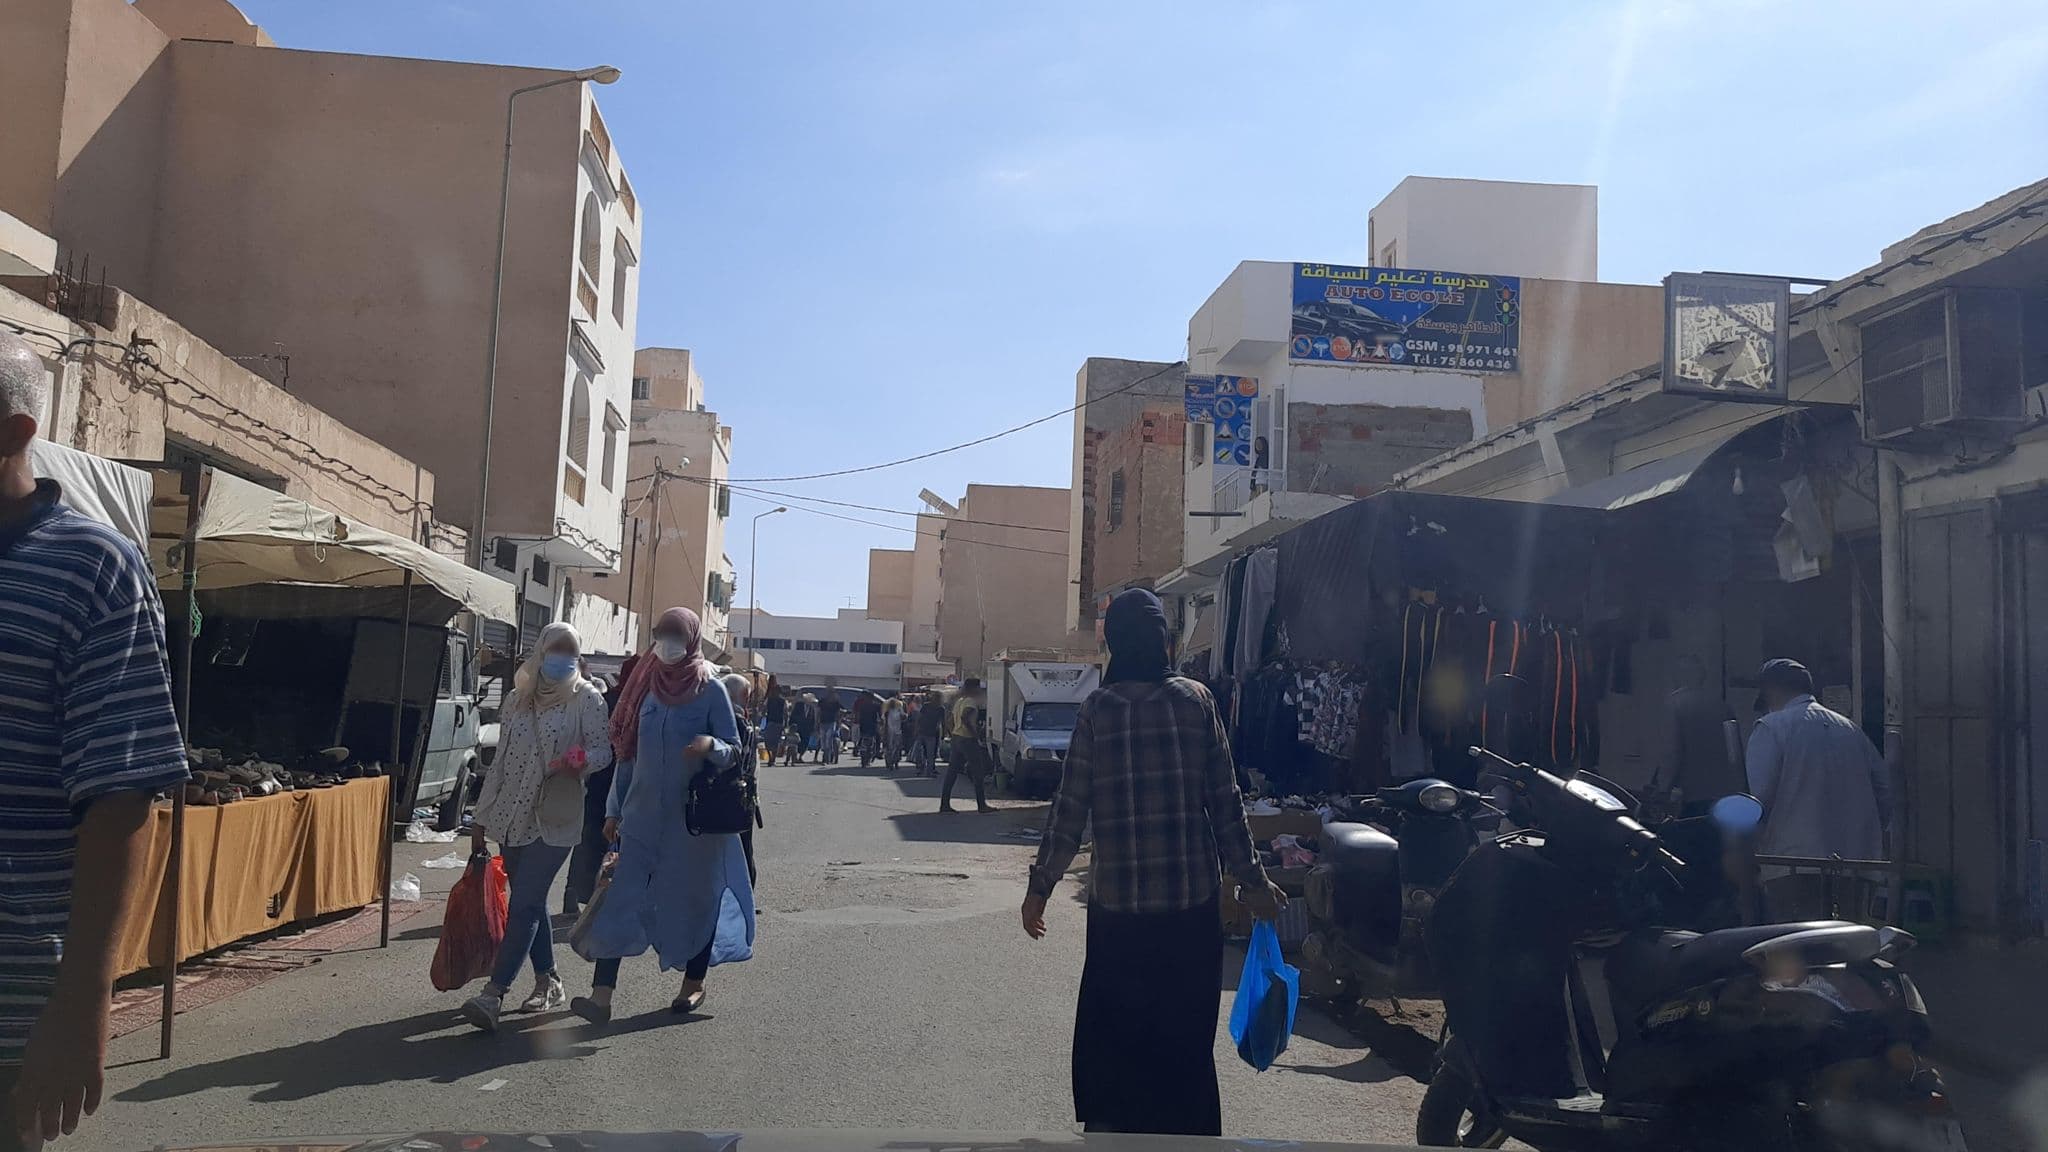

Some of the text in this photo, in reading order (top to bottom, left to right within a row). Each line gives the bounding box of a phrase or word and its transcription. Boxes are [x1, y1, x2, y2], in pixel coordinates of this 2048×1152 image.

[1302, 263, 1489, 290] مدرسة تعليم السياقة
[1325, 285, 1464, 305] AUTO ECOLE
[1405, 340, 1438, 351] GSM
[1447, 344, 1463, 353] 98
[1466, 345, 1490, 354] 971
[1440, 356, 1456, 366] 75
[1459, 358, 1483, 367] 860
